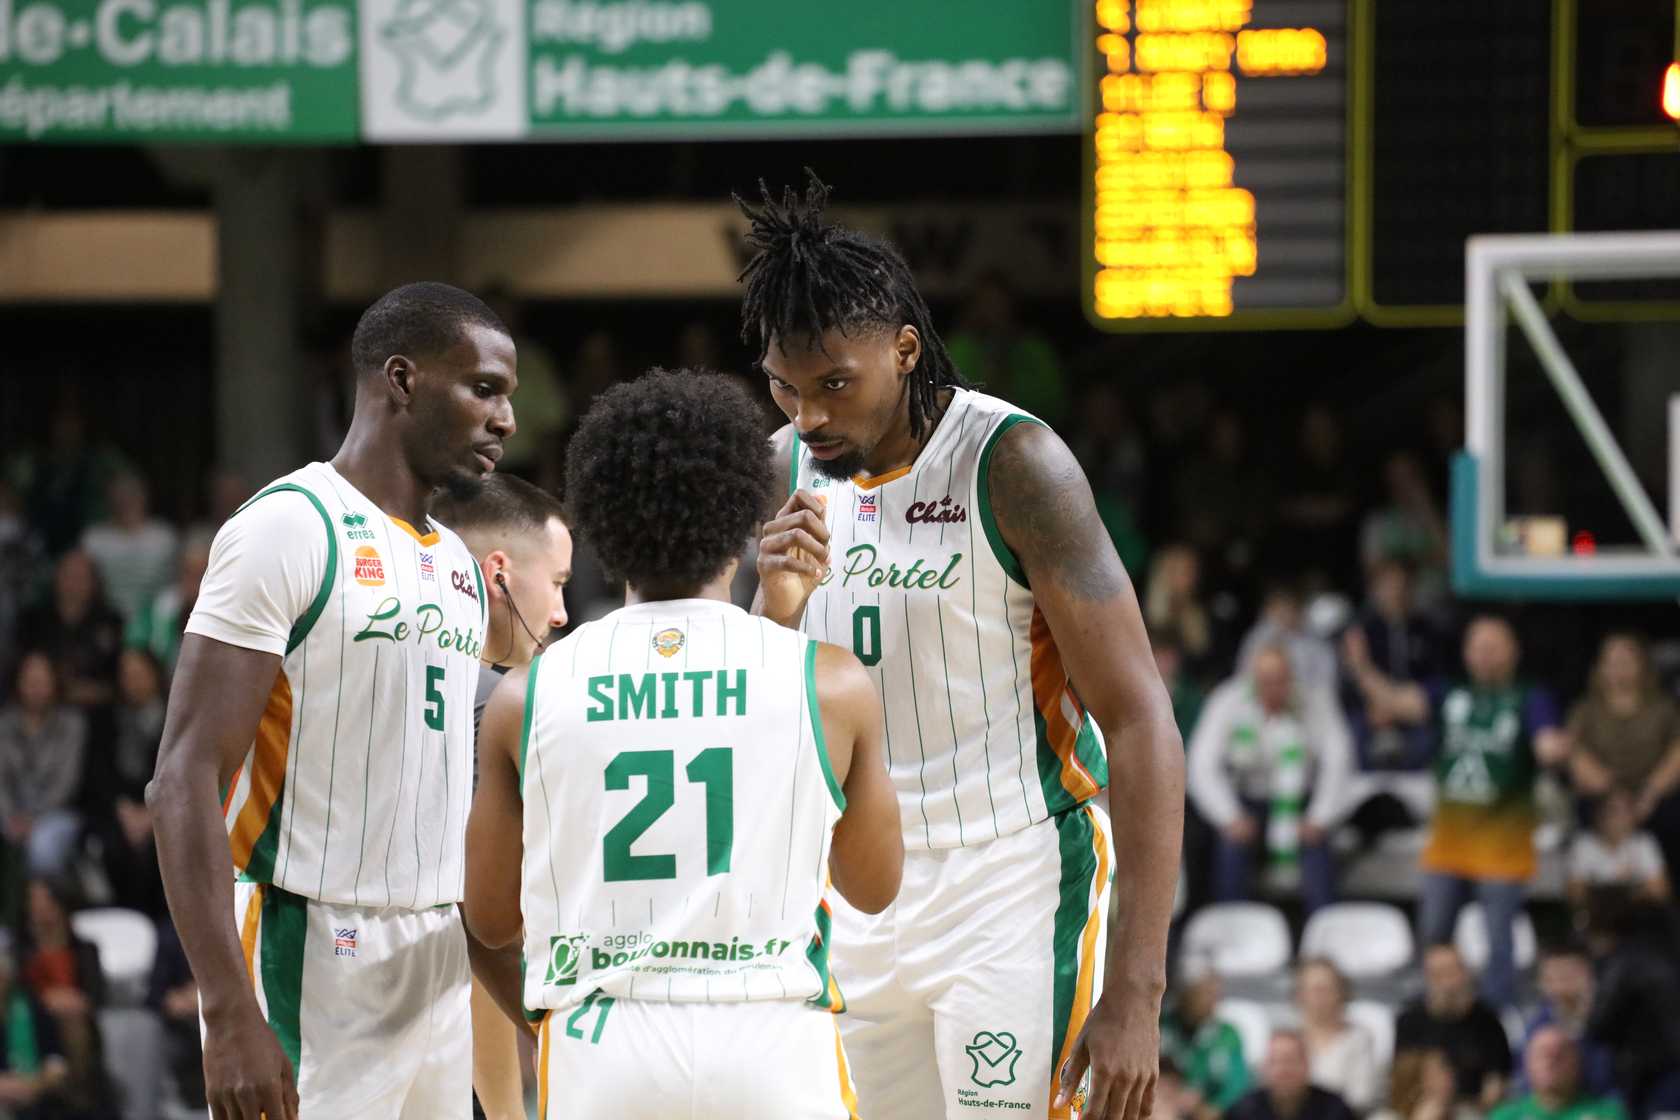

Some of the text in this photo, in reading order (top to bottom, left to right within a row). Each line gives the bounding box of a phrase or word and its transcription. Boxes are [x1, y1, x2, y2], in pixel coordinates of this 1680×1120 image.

[0, 0, 352, 67] e-Calais
[532, 50, 1070, 114] Hauts-de-France
[857, 513, 876, 522] ELITE
[905, 499, 967, 524] Chais
[354, 567, 385, 579] KING
[843, 543, 963, 590] Portel
[353, 596, 481, 660] Le Porte
[852, 605, 882, 666] 0
[424, 665, 446, 732] 5
[587, 669, 747, 722] SMITH
[603, 747, 734, 882] 21
[335, 947, 356, 957] ELITE
[603, 931, 653, 950] agglo
[957, 1088, 978, 1097] Région
[958, 1097, 1031, 1110] Hauts-de-France
